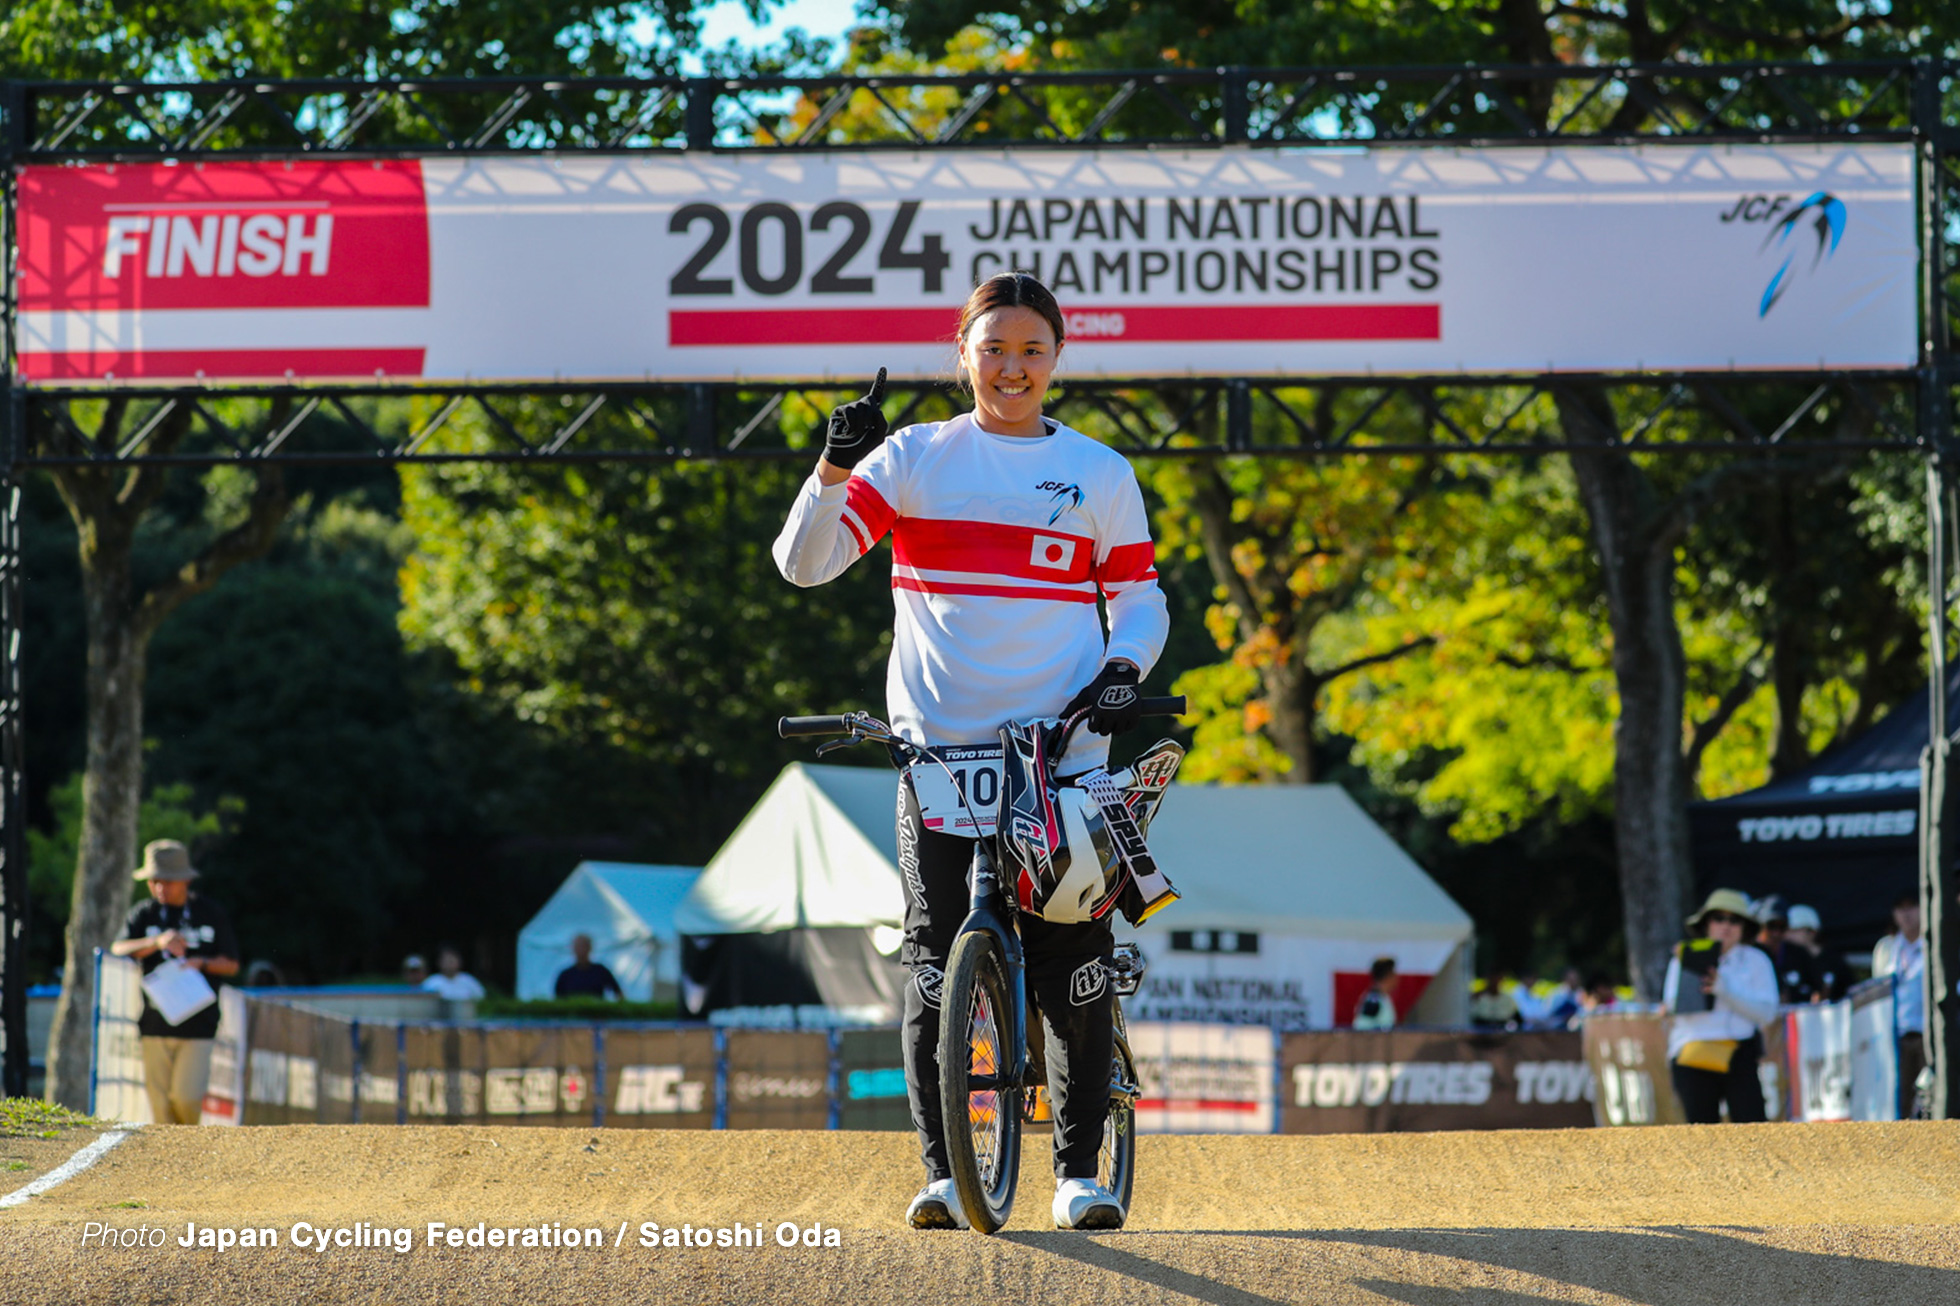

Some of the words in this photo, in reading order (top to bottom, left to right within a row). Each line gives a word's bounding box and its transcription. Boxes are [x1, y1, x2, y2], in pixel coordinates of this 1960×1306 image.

[970, 196, 1146, 241] JAPAN
[1168, 195, 1440, 240] NATIONAL
[1721, 195, 1789, 223] JCF
[103, 214, 333, 278] FINISH
[668, 200, 951, 296] 2024
[971, 248, 1440, 294] CHAMPIONSHIPS
[1035, 481, 1065, 491] JCF
[945, 751, 977, 760] TOYO
[977, 749, 1004, 758] TIRE
[950, 767, 997, 808] 10
[1738, 815, 1823, 843] TOYO
[1825, 809, 1917, 838] TIRES
[1293, 1062, 1390, 1108] TOYO
[1389, 1061, 1493, 1105] TIRES
